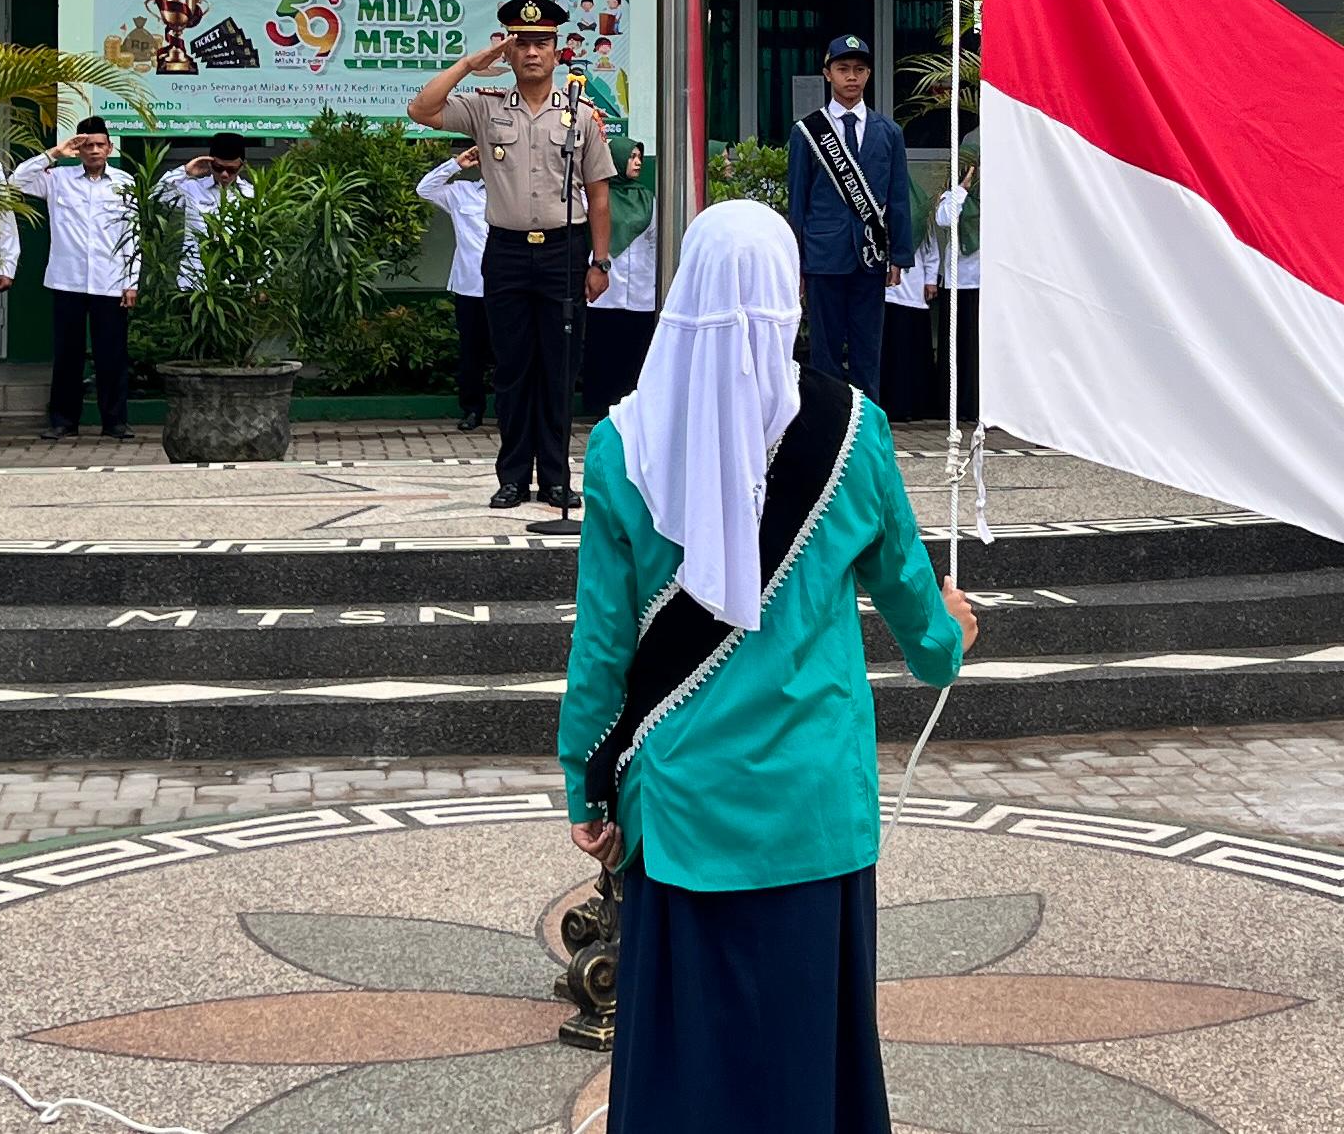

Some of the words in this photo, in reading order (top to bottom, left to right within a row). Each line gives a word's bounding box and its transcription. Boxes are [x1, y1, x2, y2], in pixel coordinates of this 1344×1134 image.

[194, 28, 221, 49] TICKET
[354, 29, 439, 54] MTsN
[444, 30, 463, 55] 2
[171, 82, 208, 93] Dengan
[210, 82, 257, 94] Semangat
[260, 82, 286, 92] Milad
[302, 83, 313, 92] 59
[343, 83, 349, 92] 2
[380, 83, 398, 93] Kita
[213, 95, 254, 104] Generasi
[257, 95, 291, 106] Bangsa
[293, 96, 316, 106] yang
[819, 132, 850, 173] AJUDAN
[841, 171, 873, 223] PEMBINA
